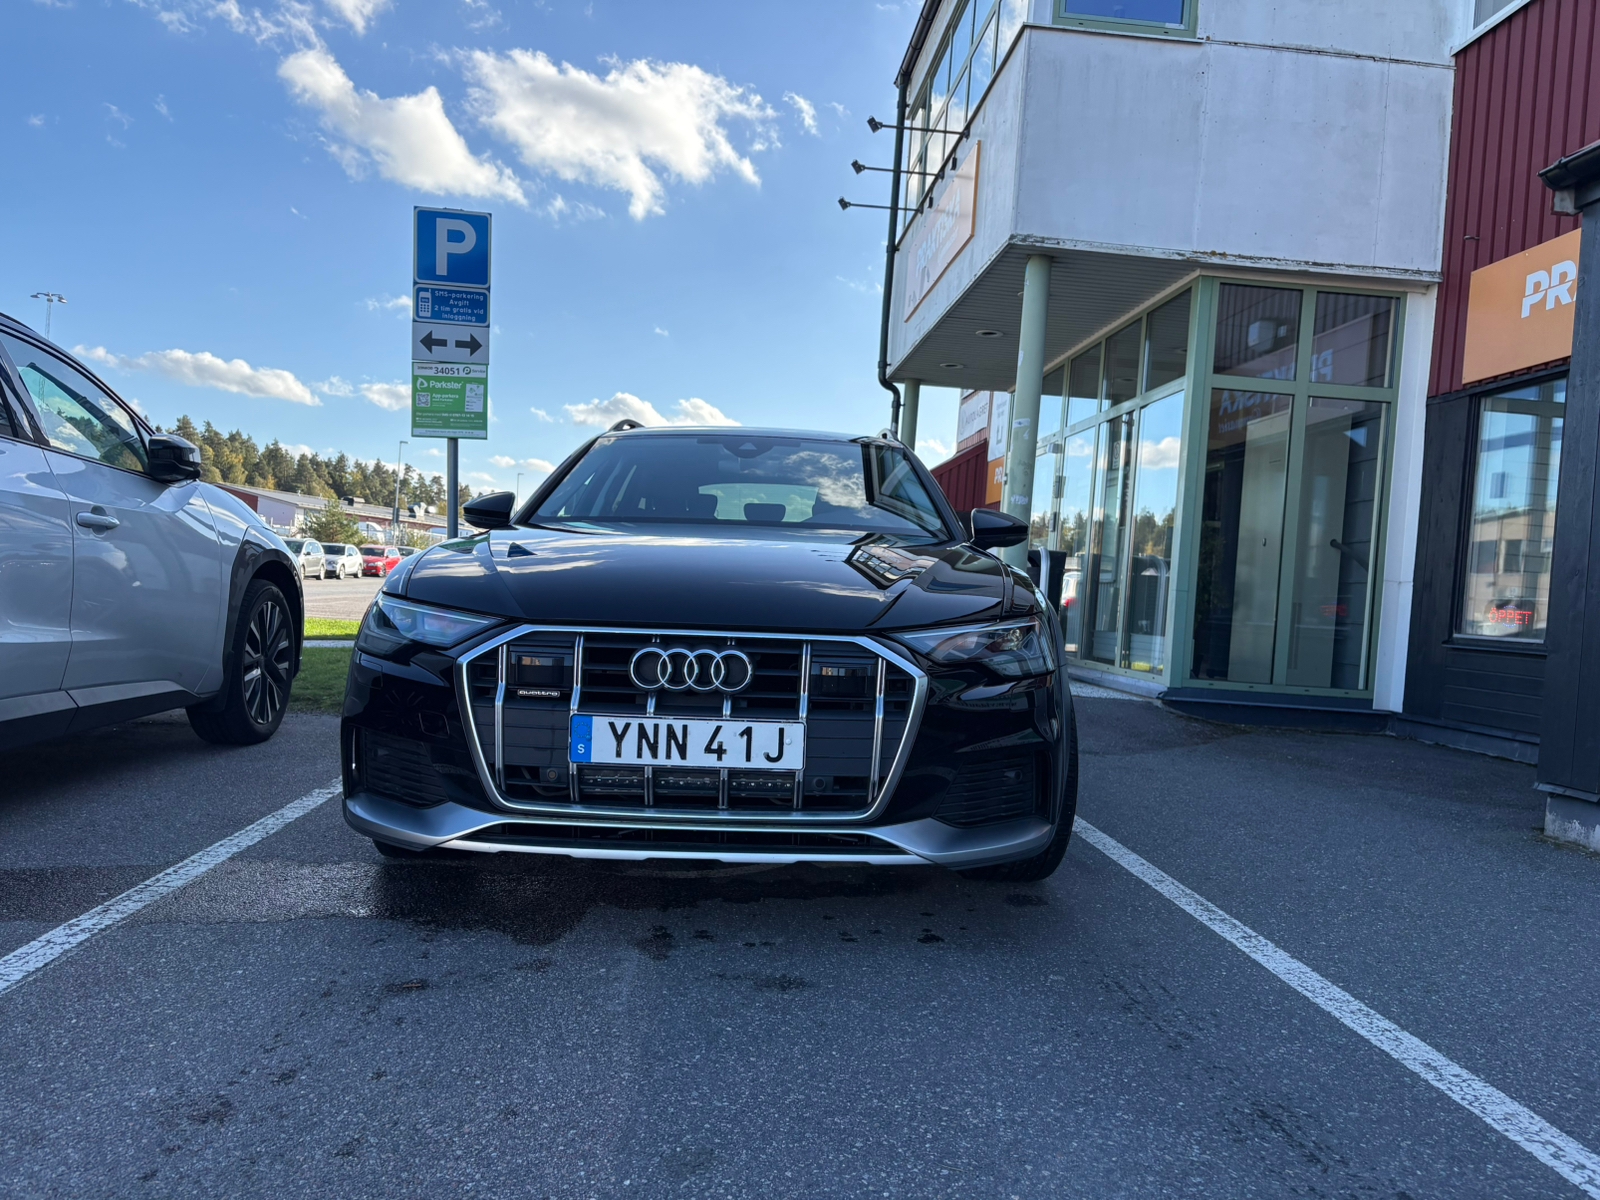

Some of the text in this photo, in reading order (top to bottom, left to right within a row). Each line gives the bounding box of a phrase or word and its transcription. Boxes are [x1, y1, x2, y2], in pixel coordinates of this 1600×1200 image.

[436, 217, 476, 276] P
[1521, 260, 1577, 319] PR
[435, 291, 484, 301] SMS-parkering
[449, 299, 469, 307] Avgift
[452, 306, 472, 314] gratis
[433, 367, 460, 375] 34051
[430, 381, 462, 389] Parkster
[1489, 607, 1532, 625] ÖPPET
[577, 721, 785, 763] S YNN 41J
